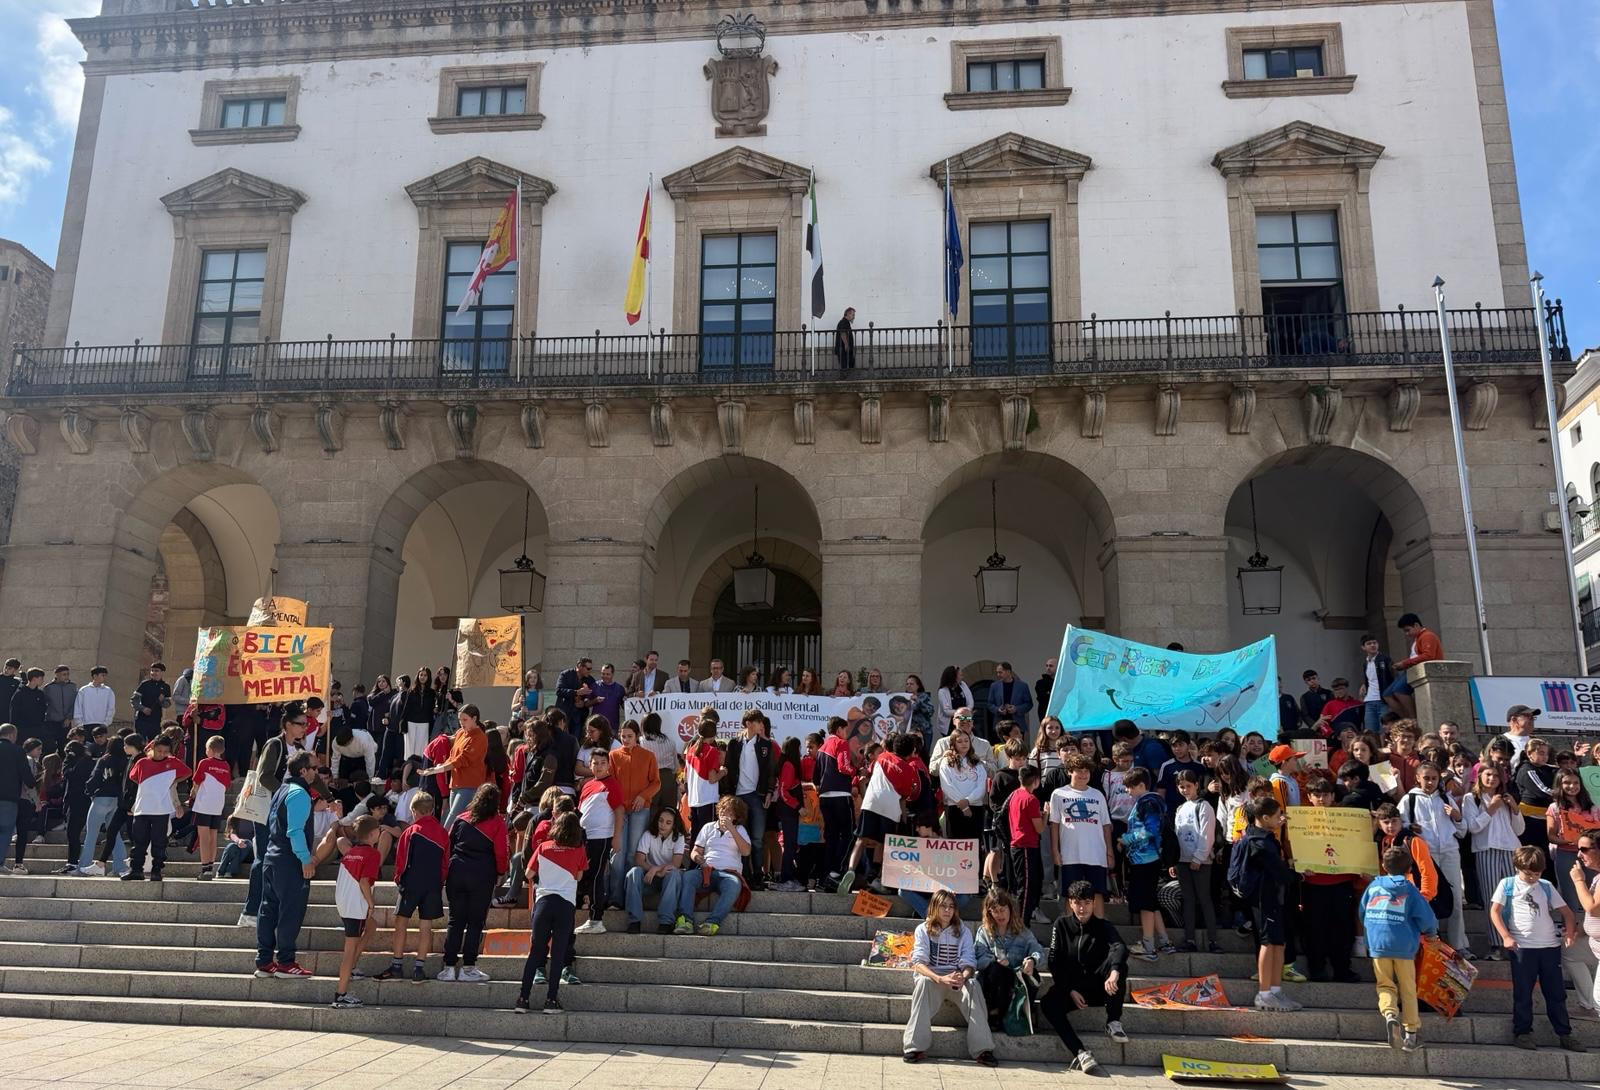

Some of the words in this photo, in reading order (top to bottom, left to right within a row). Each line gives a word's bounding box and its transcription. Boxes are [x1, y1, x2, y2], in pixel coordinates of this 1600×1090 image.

[271, 612, 302, 625] MENTAL
[243, 632, 307, 653] BIEN
[280, 653, 305, 673] ES
[244, 675, 322, 698] MENTAL
[629, 697, 667, 715] XXVIII
[688, 699, 727, 711] Mundial
[729, 699, 742, 711] de
[744, 699, 753, 711] la
[755, 699, 782, 712] Salud
[784, 701, 819, 713] Mental
[782, 713, 792, 721] en
[889, 836, 917, 849] HAZ
[926, 839, 973, 851] MATCH
[890, 850, 920, 862] CON
[903, 863, 957, 877] SALUD
[1181, 1061, 1211, 1070] NO
